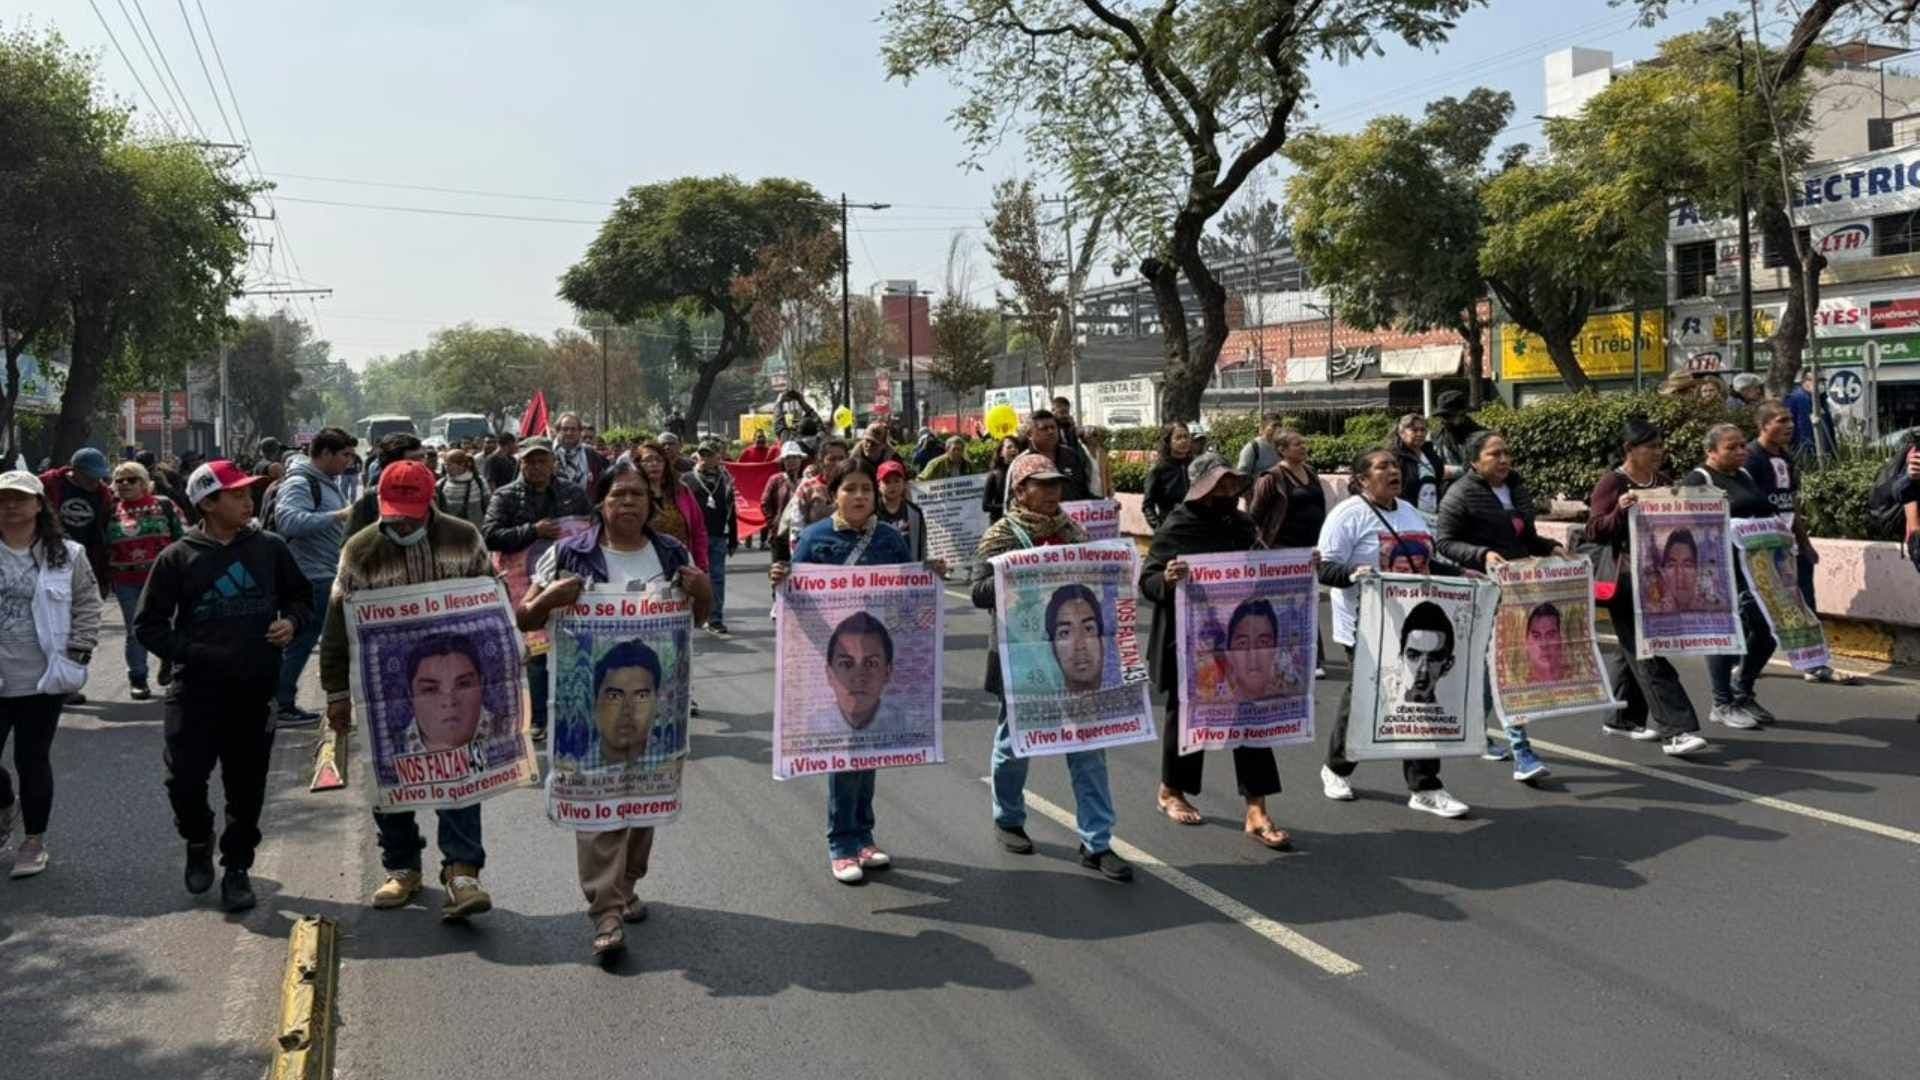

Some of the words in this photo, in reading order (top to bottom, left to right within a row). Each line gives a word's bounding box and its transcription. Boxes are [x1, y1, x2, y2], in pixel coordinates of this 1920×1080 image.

[1820, 231, 1861, 252] LTH
[1687, 356, 1722, 371] LTH
[1829, 375, 1861, 399] 46
[1005, 552, 1040, 569] ¡Vivo
[1043, 551, 1059, 563] se
[1063, 548, 1075, 562] lo
[1078, 546, 1132, 562] llevaron!
[788, 575, 826, 593] ¡Vivo
[830, 577, 848, 589] se
[852, 573, 865, 588] lo
[870, 571, 934, 587] llevaron!
[1189, 566, 1221, 583] ¡Vivo
[1225, 566, 1240, 578] se
[1244, 565, 1256, 578] lo
[1259, 561, 1313, 577] llevaron!
[357, 604, 396, 623] ¡Vivo
[400, 603, 420, 617] se
[425, 597, 440, 613] lo
[444, 590, 499, 611] llevaron!
[595, 602, 616, 616] se
[621, 599, 637, 617] lo
[1117, 597, 1136, 623] NOS
[1024, 730, 1057, 749] ¡Vivo
[1060, 728, 1073, 741] lo
[1075, 718, 1142, 742] queremos!
[1192, 727, 1225, 744] ¡Vivo
[1228, 726, 1240, 739] lo
[396, 755, 425, 784] NOS
[790, 758, 828, 776] ¡Vivo
[831, 755, 846, 770] lo
[850, 750, 927, 772] queremos!
[389, 786, 426, 805] ¡Vivo
[431, 784, 444, 798] lo
[448, 765, 523, 801] queremos!
[557, 801, 591, 820] ¡Vivo
[595, 803, 612, 819] lo
